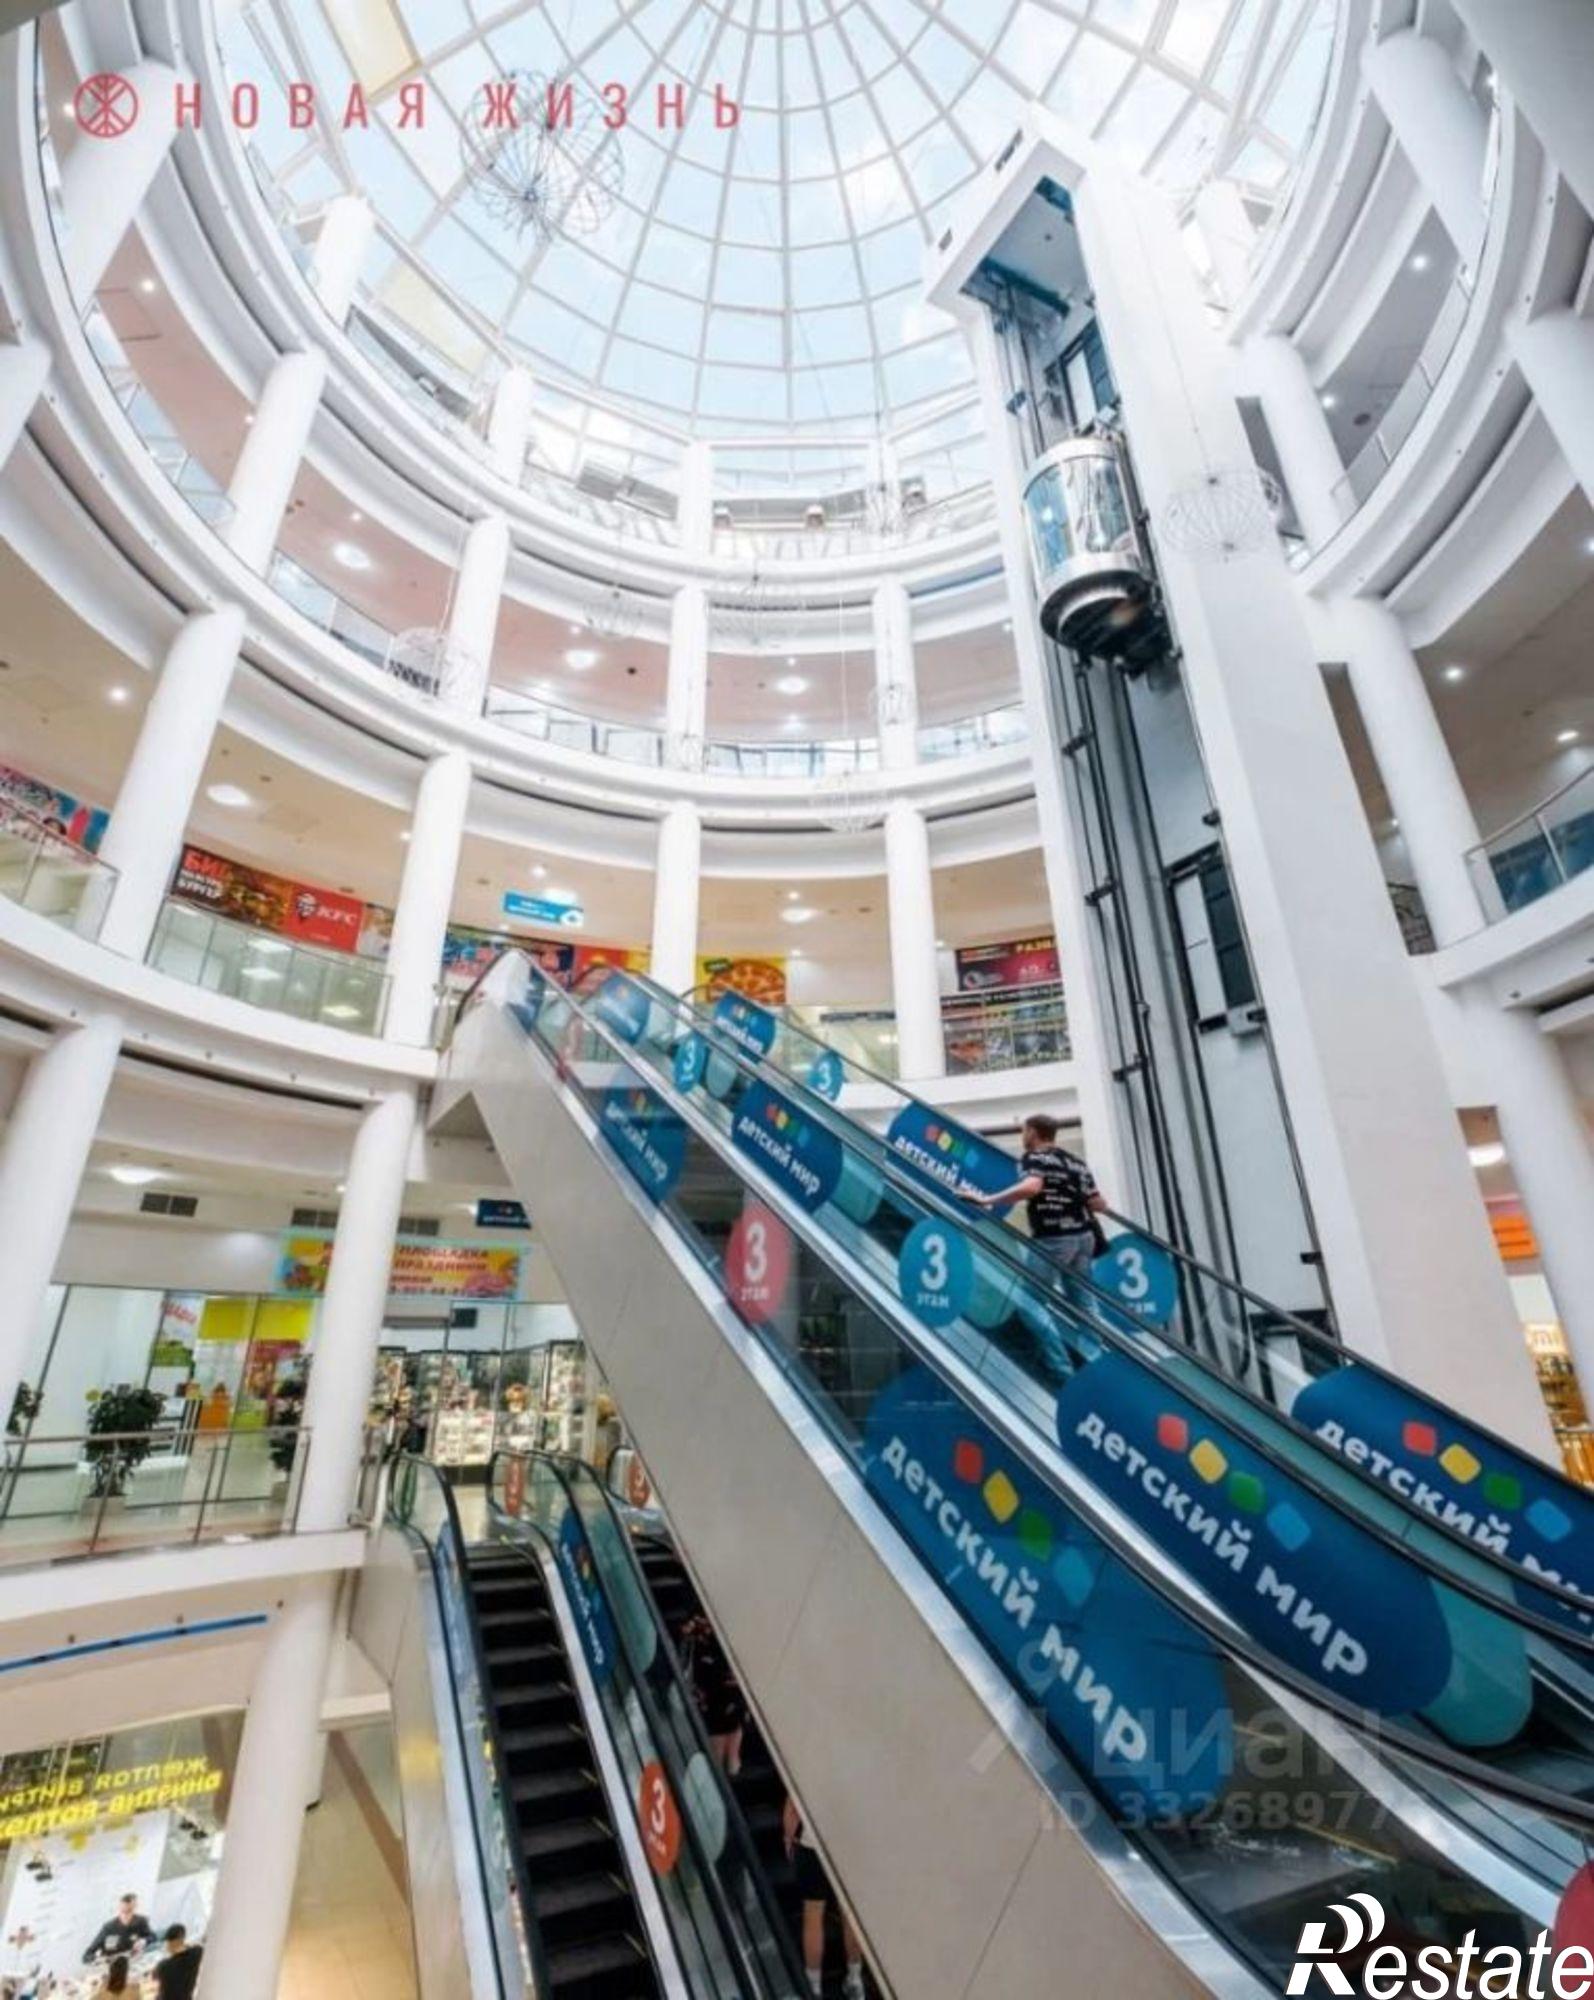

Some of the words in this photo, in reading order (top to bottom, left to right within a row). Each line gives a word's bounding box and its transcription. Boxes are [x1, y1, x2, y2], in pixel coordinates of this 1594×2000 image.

[316, 906, 358, 926] KFC
[817, 1061, 832, 1094] 3
[736, 1116, 793, 1168] детский
[787, 1156, 822, 1197] мир
[894, 1135, 960, 1187] детский
[744, 1221, 768, 1282] 3
[920, 1233, 948, 1291] 3
[1117, 1247, 1149, 1299] 3
[1316, 1420, 1513, 1555] детский
[1076, 1412, 1254, 1573] детский
[1255, 1565, 1369, 1676] мир
[880, 1436, 1040, 1630] детский
[1040, 1623, 1148, 1762] мир
[651, 1776, 666, 1835] 3
